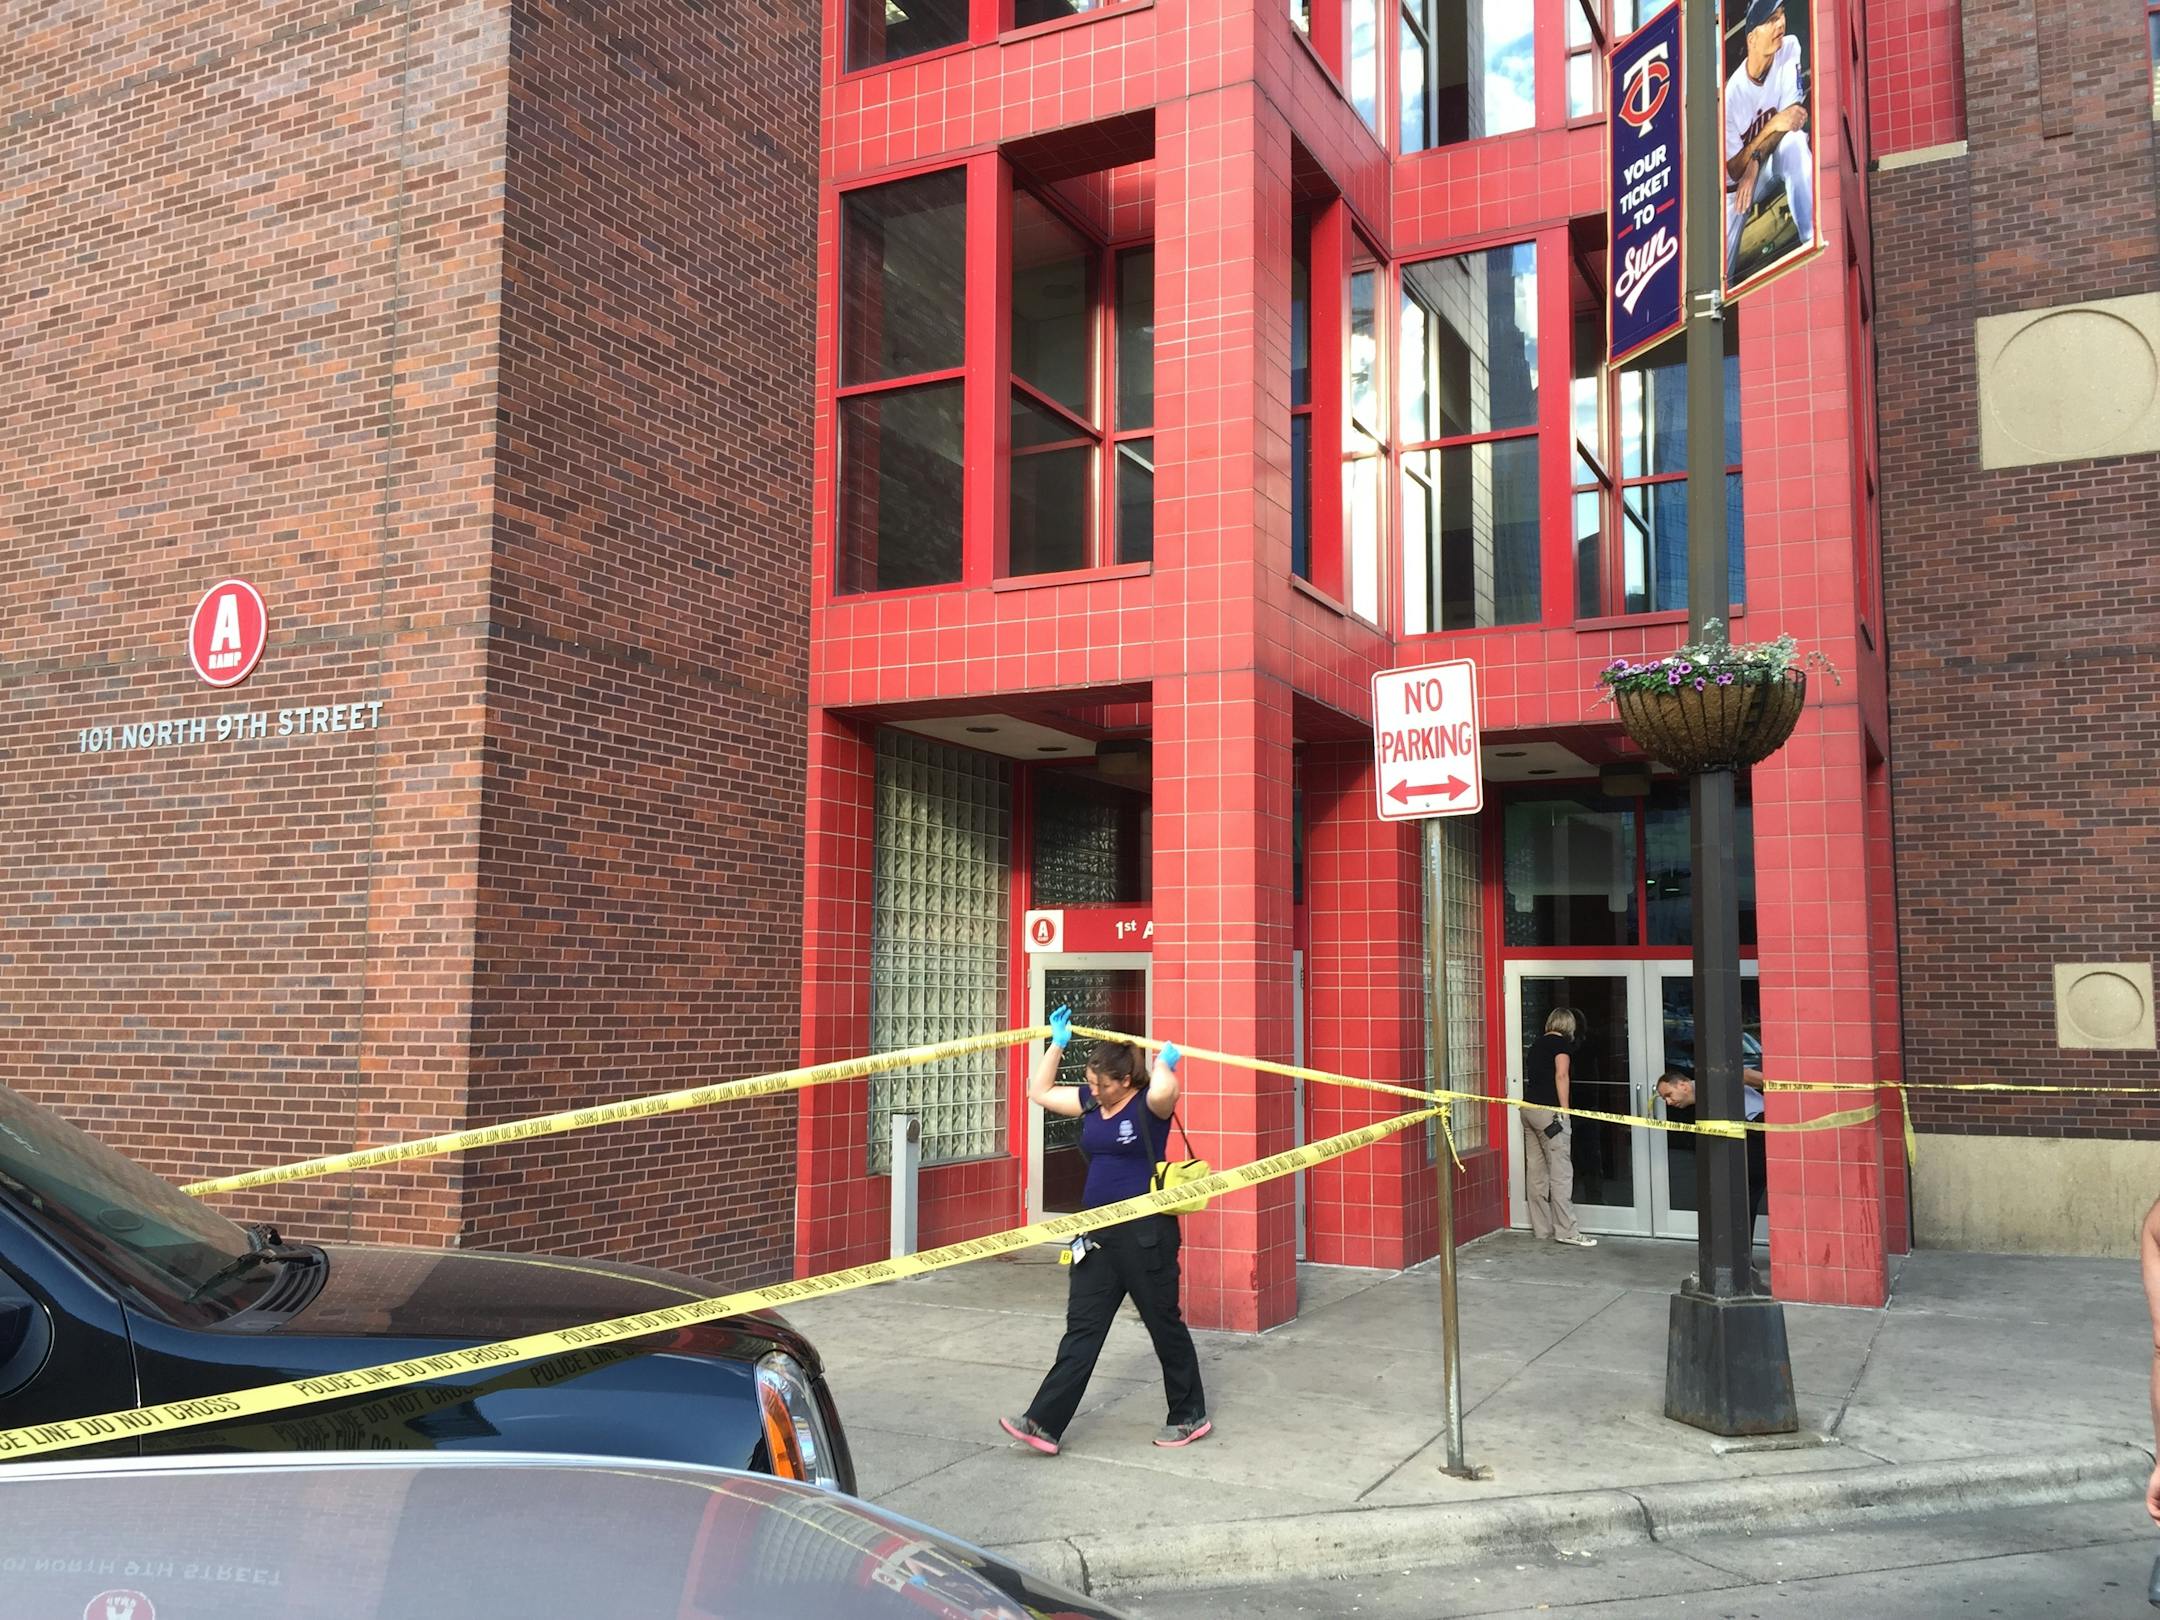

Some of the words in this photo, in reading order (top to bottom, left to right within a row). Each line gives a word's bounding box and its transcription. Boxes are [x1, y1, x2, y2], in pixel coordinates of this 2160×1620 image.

[1623, 144, 1667, 186] YOUR
[1619, 167, 1672, 215] TICKET
[1633, 203, 1656, 231] TO
[210, 594, 242, 652] A
[208, 652, 242, 670] RAMP
[1404, 678, 1443, 714] NO
[79, 728, 113, 753] 101
[121, 719, 207, 749] NORTH
[216, 713, 268, 742] 9TH
[278, 701, 384, 736] STREET
[1381, 721, 1472, 764] PARKING
[1115, 920, 1137, 940] 1st
[755, 1283, 801, 1302] POLICE
[797, 1278, 824, 1294] LINE
[819, 1274, 841, 1289] DO
[835, 1268, 860, 1285] NOT
[857, 1262, 896, 1280] CROSS
[555, 1325, 610, 1345] POLICE
[604, 1320, 636, 1337] LINE
[634, 1313, 660, 1328] DO
[656, 1308, 688, 1324] NOT
[684, 1299, 731, 1319] CROSS
[292, 1375, 361, 1397] POLICE
[354, 1368, 400, 1389] LINE
[393, 1361, 427, 1378] DO
[423, 1354, 463, 1374] NOT
[460, 1343, 520, 1365] CROSS
[23, 1423, 80, 1445] LINE
[77, 1419, 117, 1436] DO
[113, 1409, 164, 1430] NOT
[163, 1396, 241, 1420] CROSS
[361, 1406, 389, 1425] DO
[390, 1392, 425, 1417] NOT
